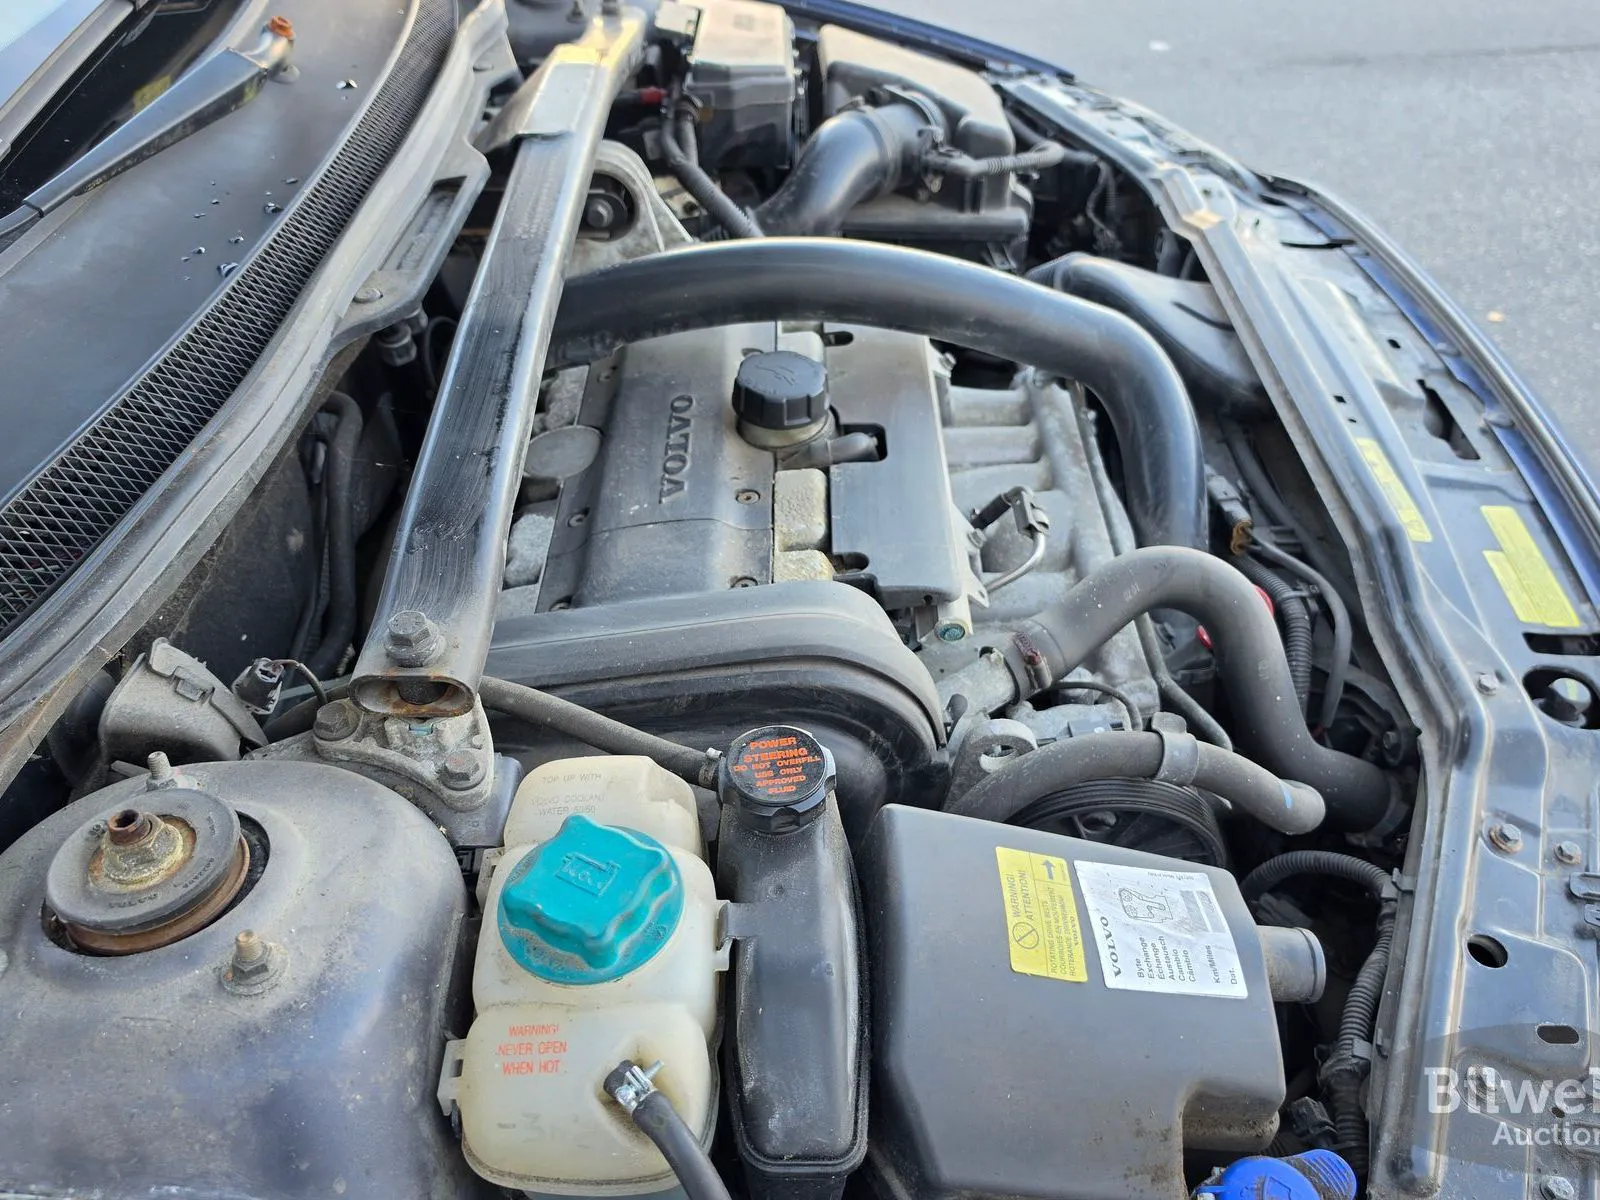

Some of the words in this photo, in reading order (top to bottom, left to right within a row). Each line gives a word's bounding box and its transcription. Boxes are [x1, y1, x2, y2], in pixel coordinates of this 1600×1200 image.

[659, 394, 694, 504] VOLVO
[750, 737, 796, 749] POWER
[744, 747, 808, 762] STEERING
[751, 761, 771, 770] NOT
[776, 755, 821, 767] OVERFILL
[542, 775, 559, 784] TOP
[562, 774, 576, 783] UP
[580, 773, 602, 783] WITH
[754, 770, 774, 778] USE
[779, 766, 803, 775] ONLY
[756, 775, 806, 787] APPROVED
[767, 785, 797, 794] FLUID
[1006, 874, 1020, 918] WARNING!
[1019, 871, 1034, 920] ATTENTION!
[1100, 916, 1122, 978] VOLVO
[1048, 939, 1058, 974] ROTATING
[1139, 937, 1155, 979] Exchange
[1158, 935, 1176, 981] Austausch
[1172, 949, 1186, 982] Cambio
[1205, 945, 1220, 984] Km/Miles
[1135, 958, 1145, 978] Byte
[1229, 967, 1238, 985] Dat.
[508, 1024, 560, 1037] WARNING!
[497, 1042, 533, 1056] NEVER
[538, 1040, 568, 1054] OPEN
[503, 1061, 533, 1074] WHEN
[539, 1059, 560, 1073] HOT
